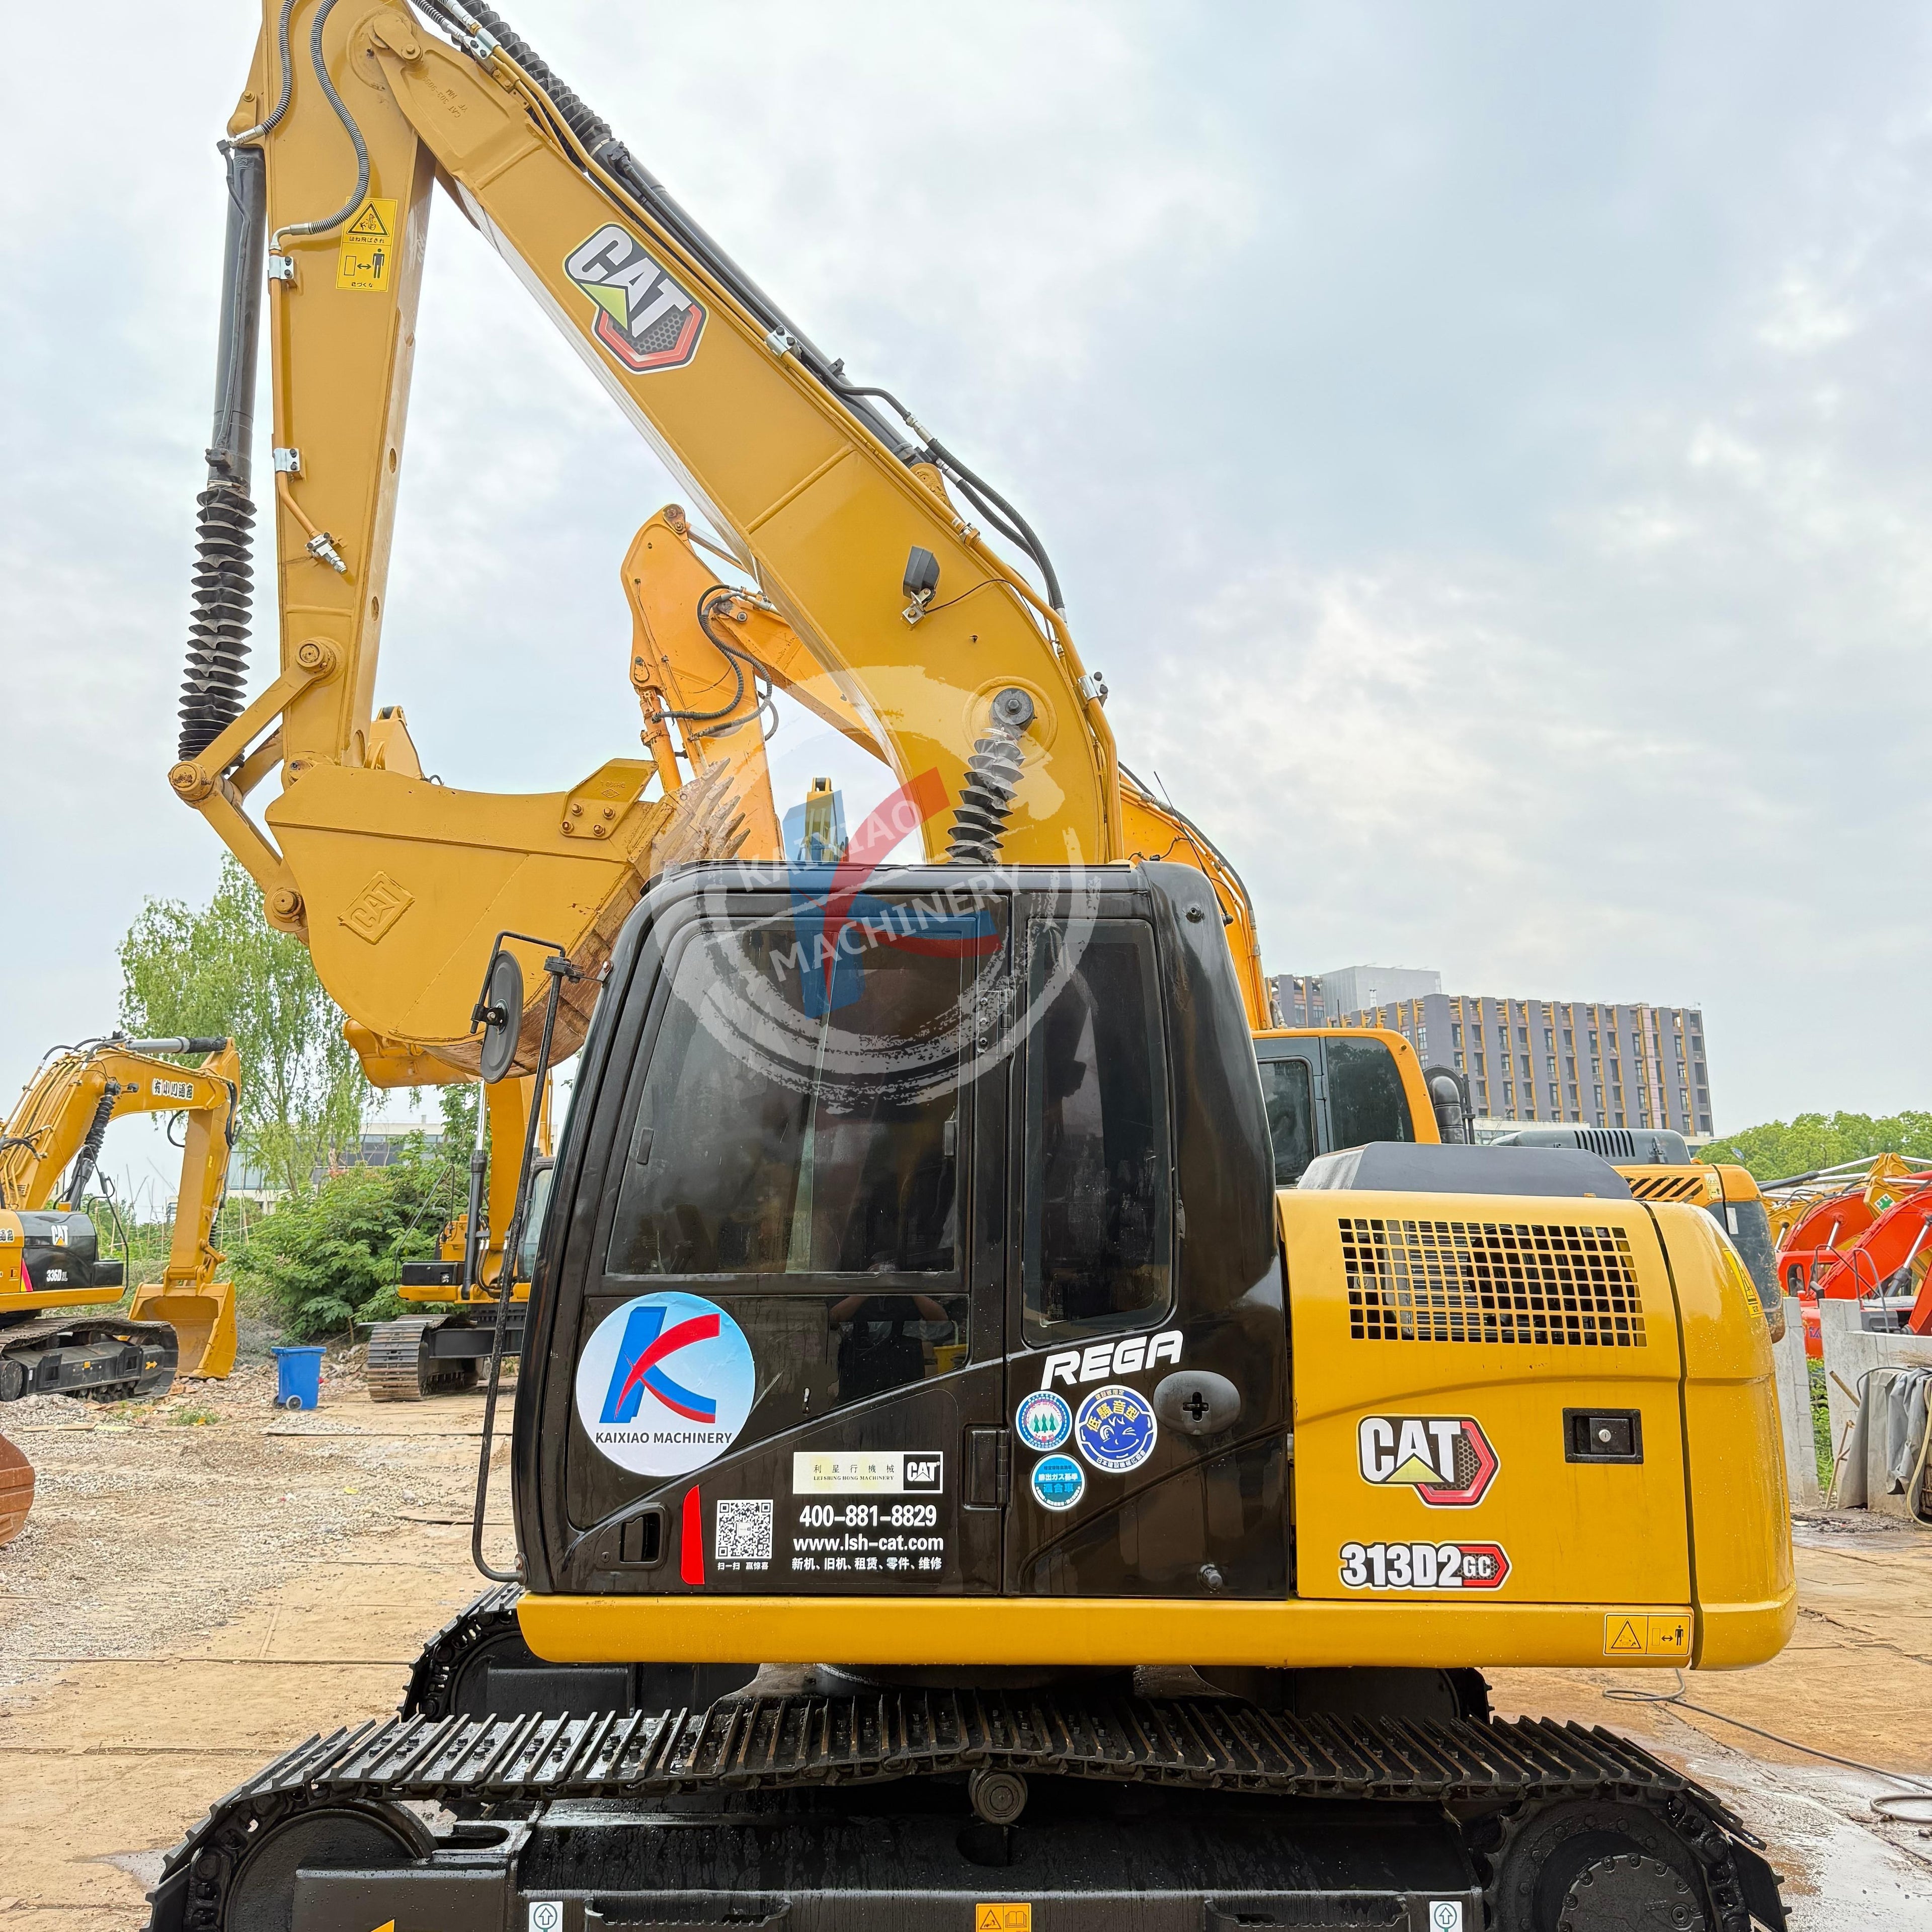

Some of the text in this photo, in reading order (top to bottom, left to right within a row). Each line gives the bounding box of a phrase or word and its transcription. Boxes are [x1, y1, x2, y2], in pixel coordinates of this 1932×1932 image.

[568, 226, 692, 338] CAT
[350, 880, 400, 934] CAT
[51, 1225, 68, 1245] CAT
[1040, 1330, 1183, 1389] REGA
[596, 1432, 732, 1443] KAIXIAO MACHINERY
[1360, 1418, 1461, 1483] CAT
[799, 1505, 937, 1527] 400-881-8829
[793, 1533, 944, 1551] www.lsh-cat.com
[717, 1562, 740, 1570] 扫一扫
